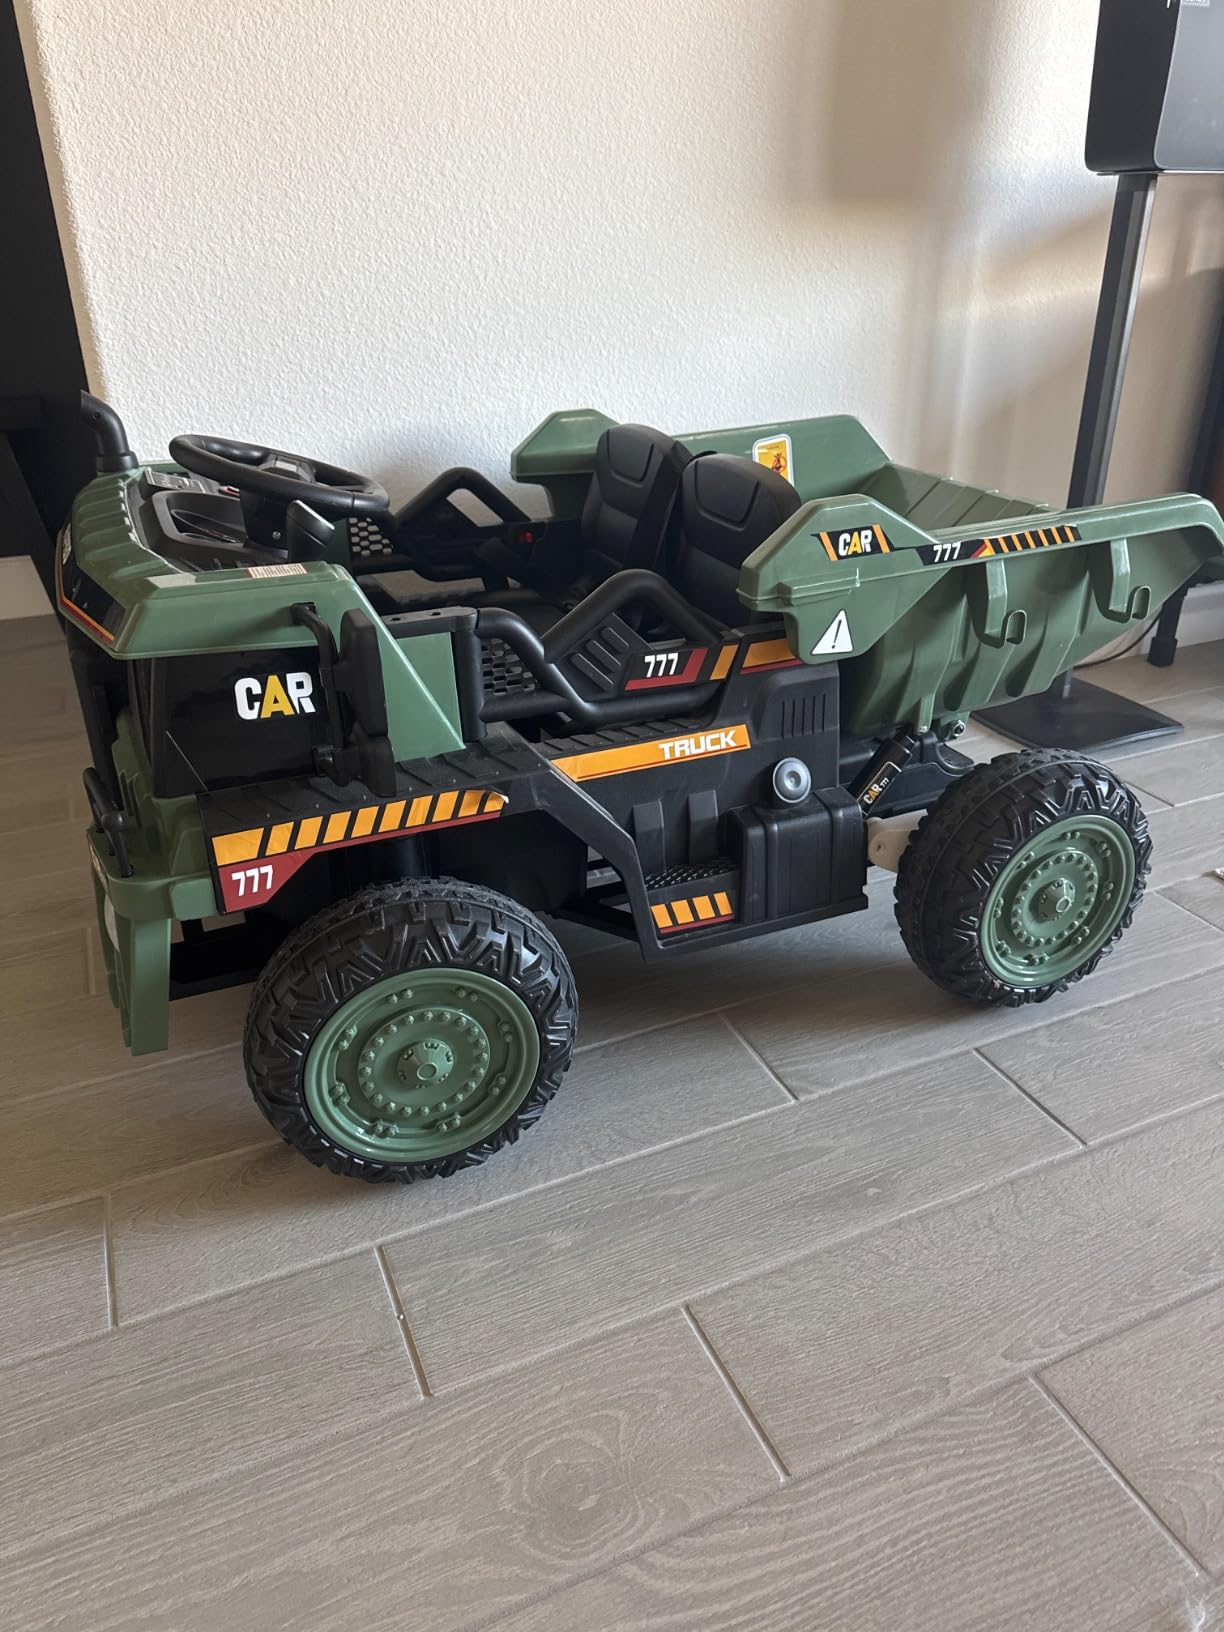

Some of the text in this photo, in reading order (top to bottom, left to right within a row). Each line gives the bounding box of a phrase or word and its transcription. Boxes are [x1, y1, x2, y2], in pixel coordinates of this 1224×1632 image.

[838, 529, 873, 556] CAR
[933, 541, 962, 563] 777
[644, 652, 679, 678] 777
[234, 672, 316, 720] CAR
[658, 729, 737, 761] TRUCK
[863, 783, 883, 804] CAR
[231, 864, 274, 897] 777
